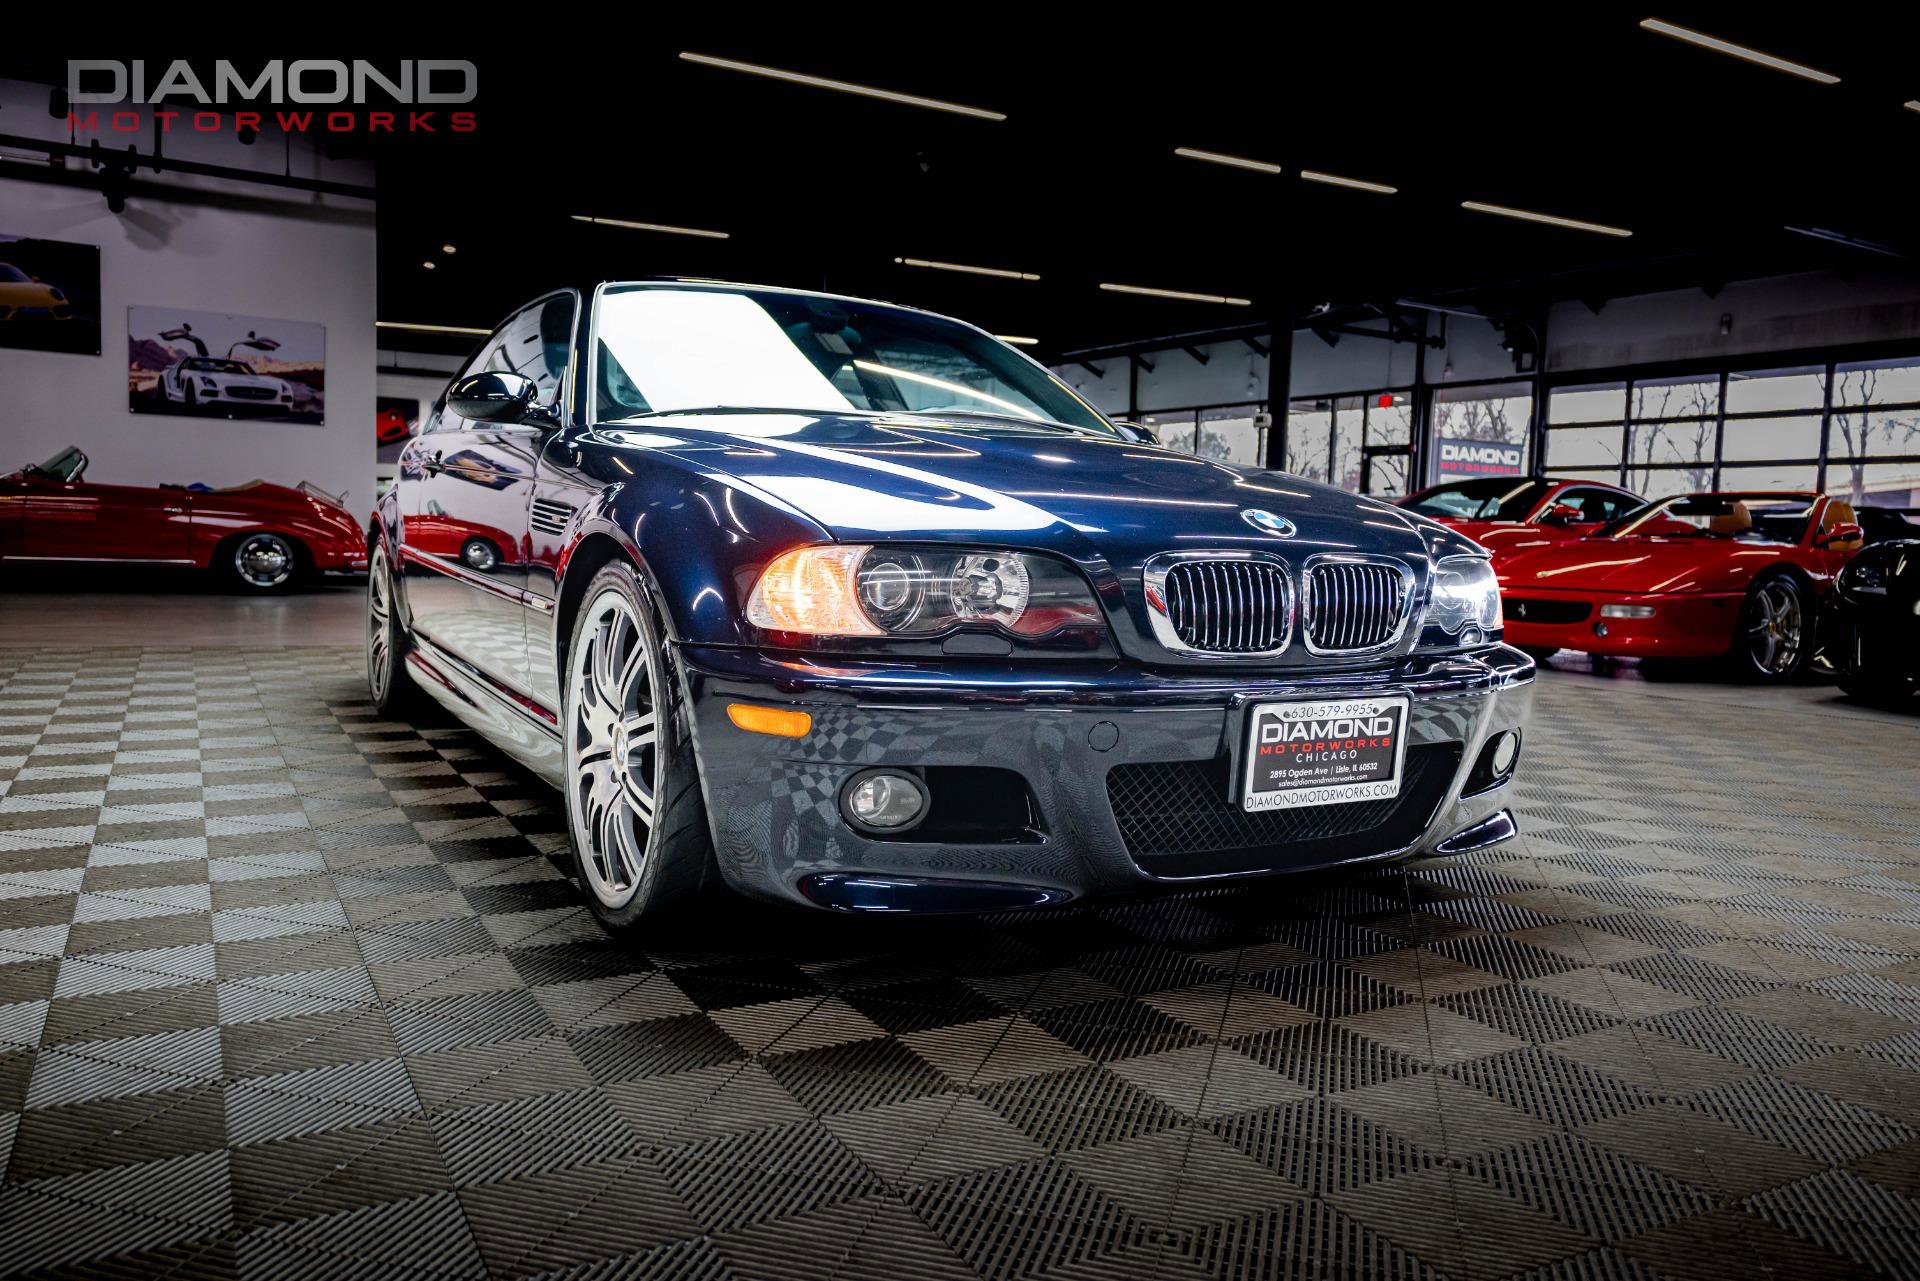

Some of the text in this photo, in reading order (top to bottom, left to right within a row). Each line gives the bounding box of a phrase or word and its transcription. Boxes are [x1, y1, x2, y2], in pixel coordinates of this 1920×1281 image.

[1441, 445, 1520, 465] DIAMOND
[1291, 703, 1373, 719] 630-579-9955
[1261, 717, 1394, 743] DIAMOND
[1260, 737, 1392, 755] MOTORWORKS
[1296, 750, 1358, 763] CHICAGO
[1270, 769, 1287, 779] 2895
[1288, 768, 1313, 779] Ogden
[1314, 767, 1328, 775] Ave
[1246, 784, 1398, 809] DIAMONDMOTORWORKS.COM
